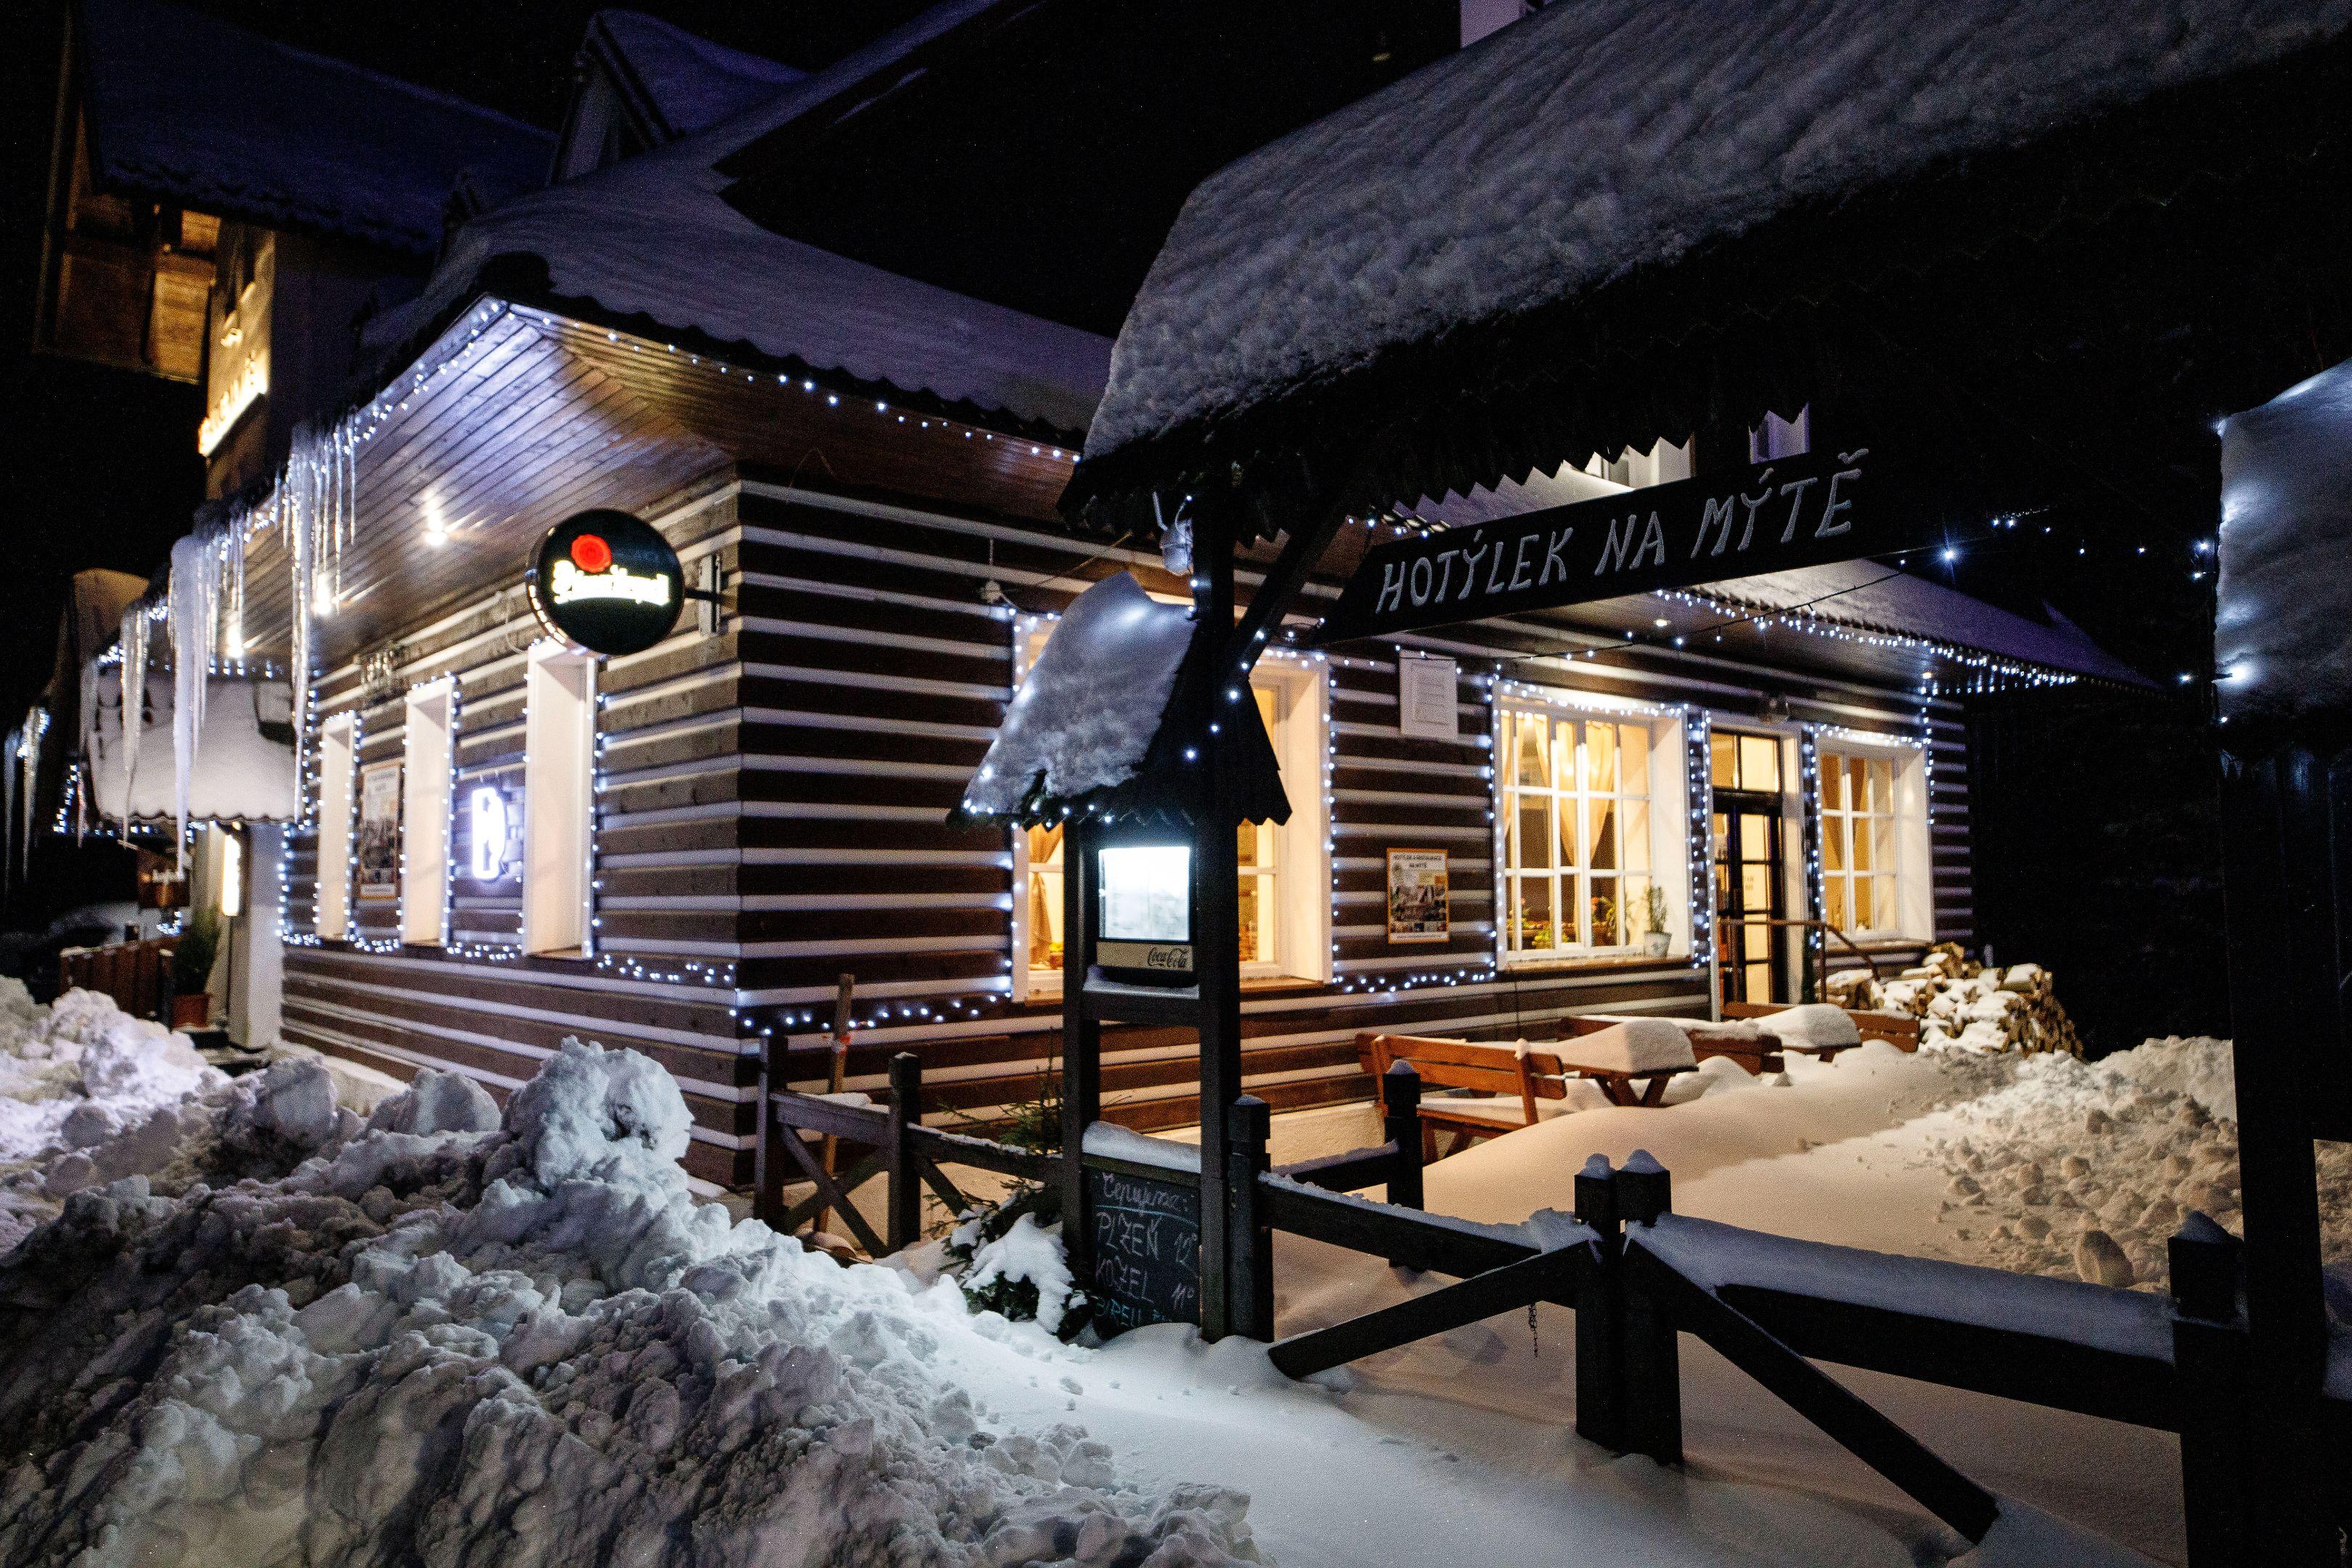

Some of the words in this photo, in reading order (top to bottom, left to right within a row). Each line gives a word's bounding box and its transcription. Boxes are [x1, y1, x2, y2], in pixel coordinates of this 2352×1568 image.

[1376, 530, 1573, 614] HOTÝLEK
[1595, 510, 1665, 576] NA
[1691, 448, 1869, 559] MÝTĚ
